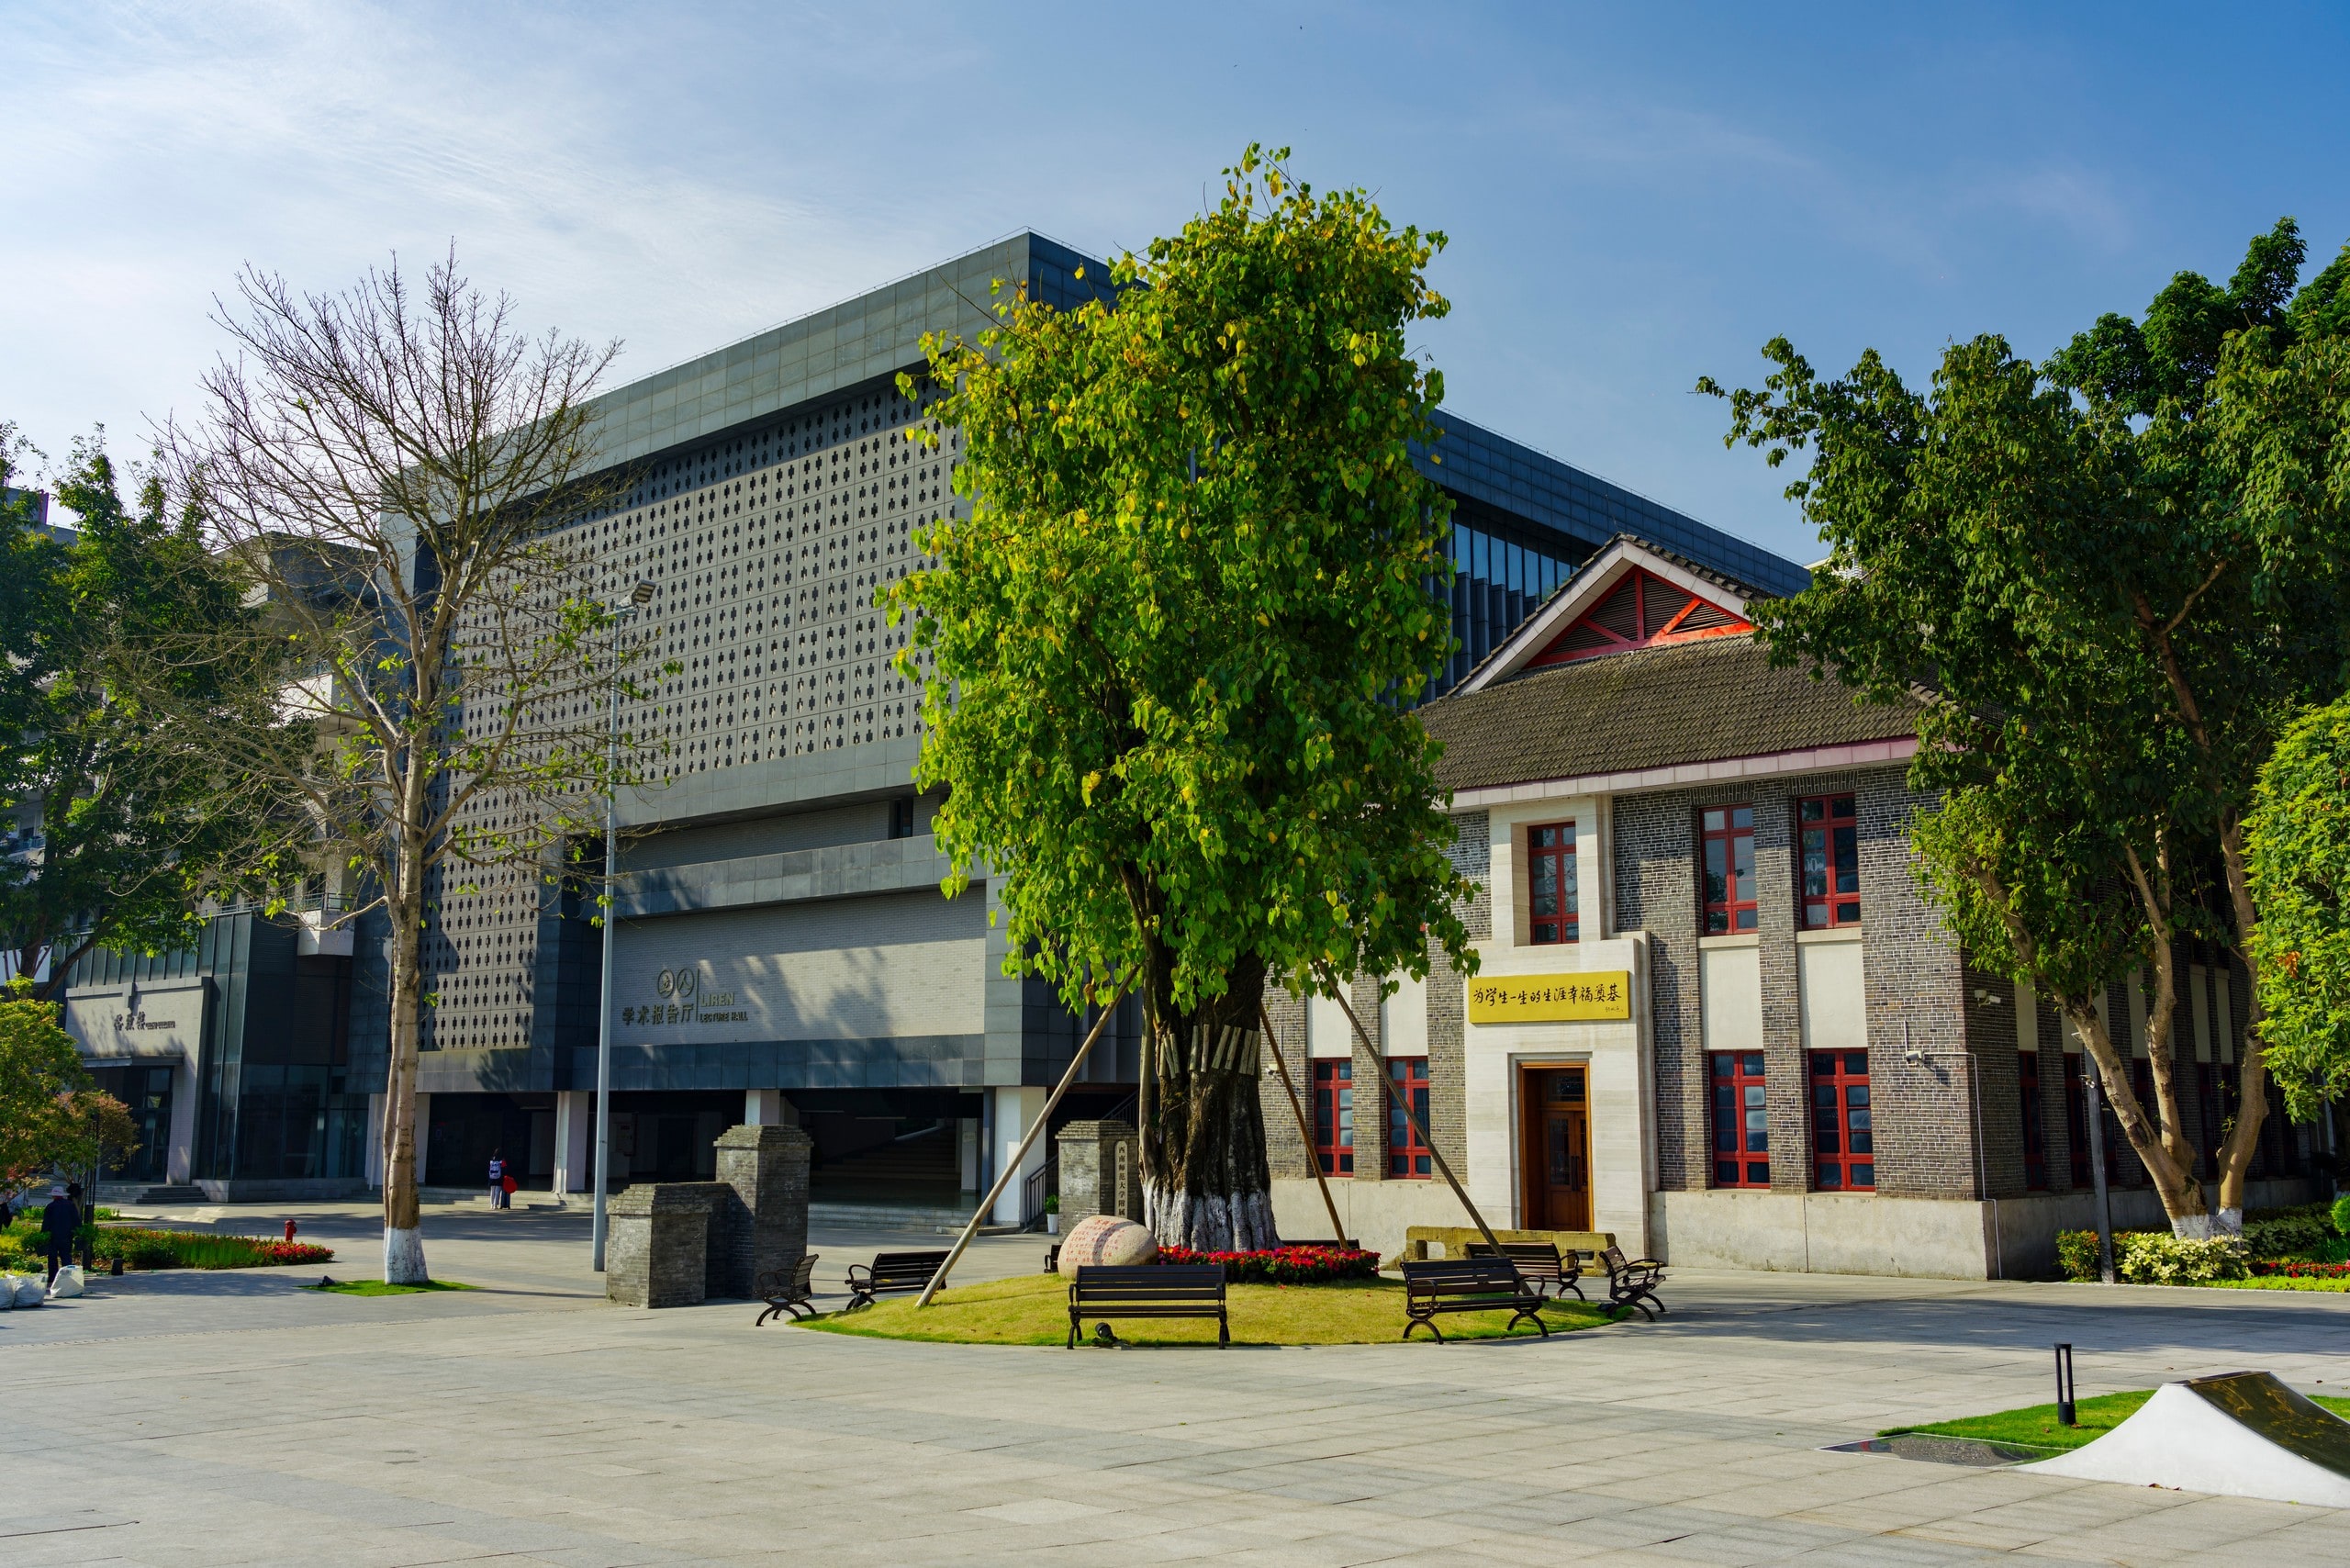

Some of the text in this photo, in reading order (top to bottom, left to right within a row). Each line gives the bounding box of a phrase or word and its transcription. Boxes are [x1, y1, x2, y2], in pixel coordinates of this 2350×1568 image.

[701, 992, 734, 1007] LIREN
[1473, 982, 1621, 1006] 为学生一生的生涯幸福奠基
[622, 1003, 693, 1025] 学术报告厅
[699, 1011, 748, 1023] LECTURE HALL
